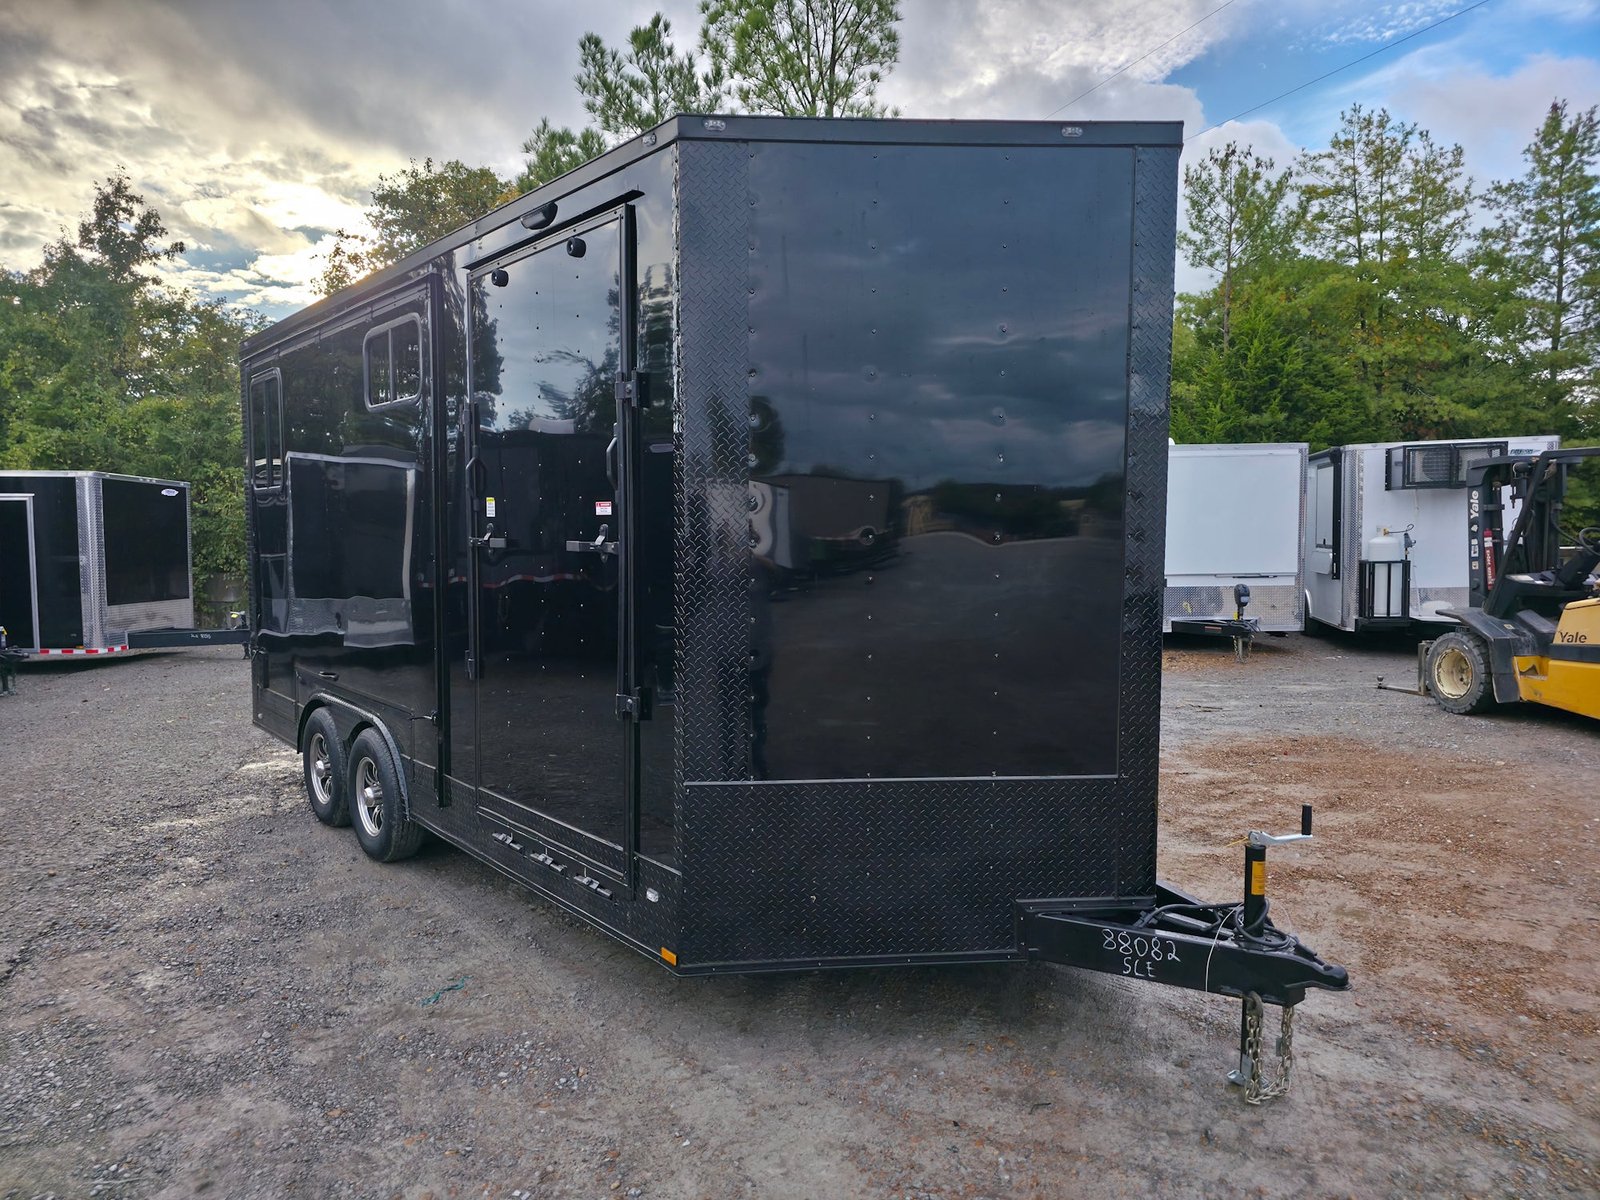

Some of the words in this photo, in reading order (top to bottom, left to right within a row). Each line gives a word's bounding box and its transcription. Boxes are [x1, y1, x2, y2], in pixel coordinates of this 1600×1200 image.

[1470, 490, 1479, 519] Yale
[1560, 631, 1587, 643] Yale
[1122, 956, 1156, 977] SLE
